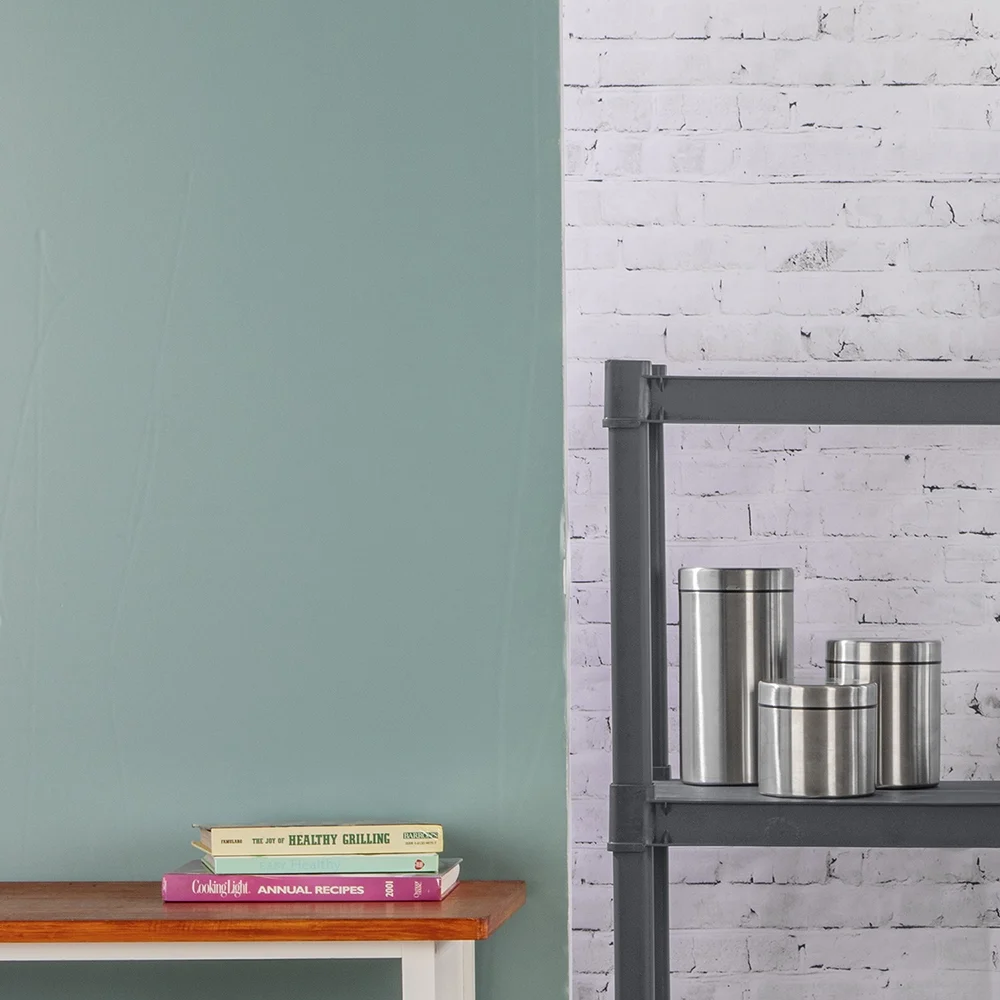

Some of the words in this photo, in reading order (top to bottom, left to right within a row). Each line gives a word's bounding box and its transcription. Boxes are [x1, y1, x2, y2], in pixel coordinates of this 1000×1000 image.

[288, 834, 338, 846] HEALTHY
[342, 833, 391, 845] GRILLING
[257, 886, 312, 895] ANNUAL
[314, 886, 365, 895] RECIPES
[385, 880, 394, 898] 2001
